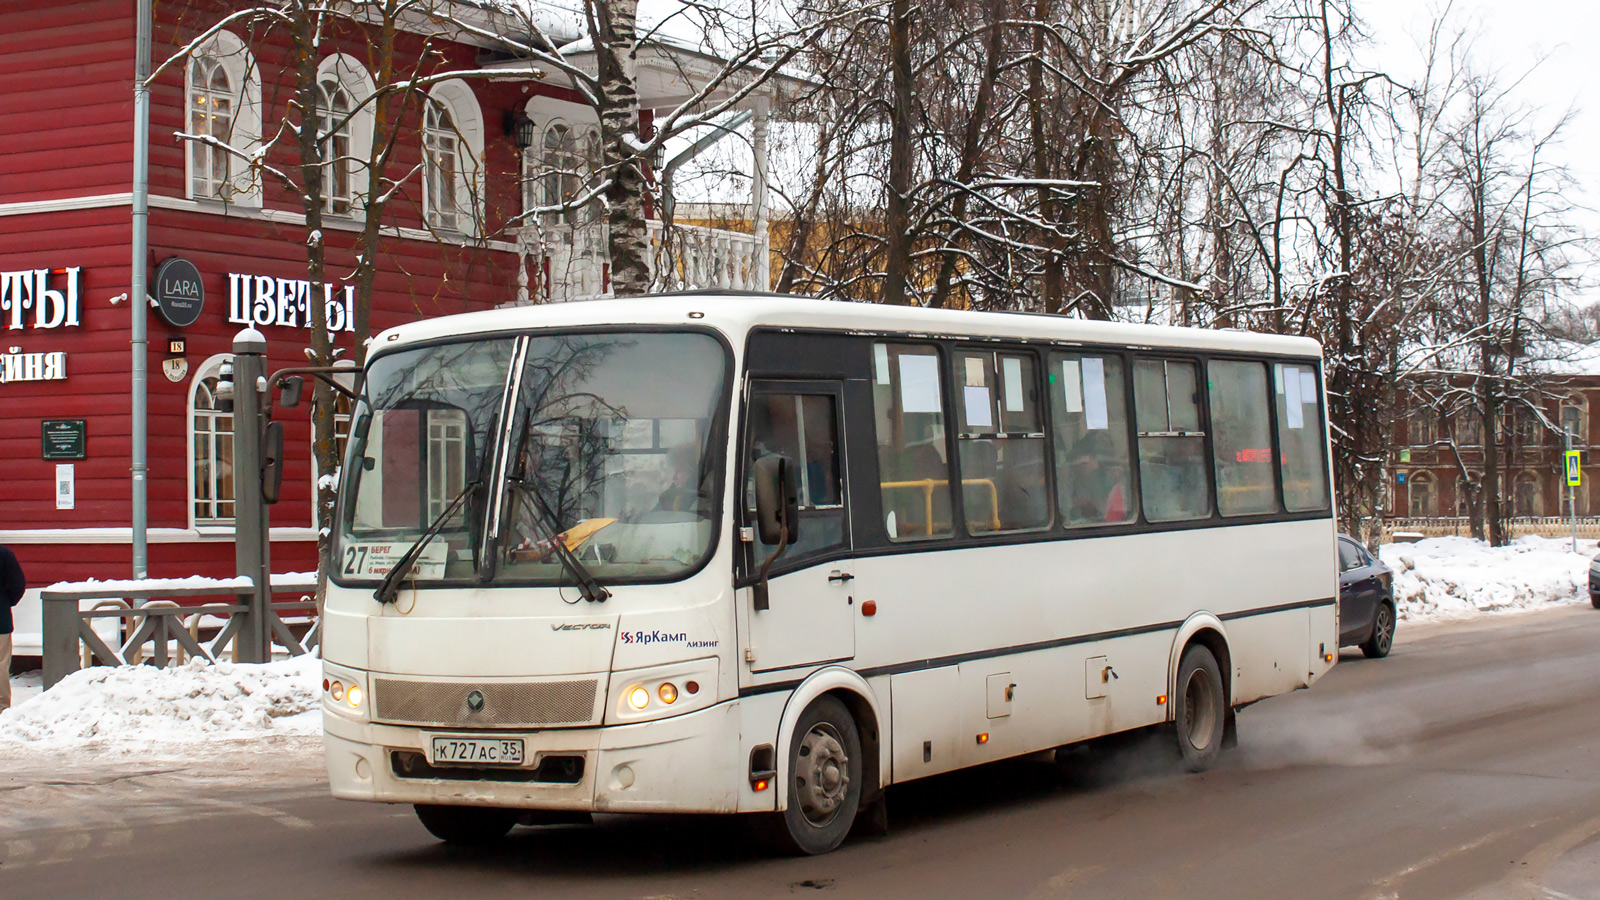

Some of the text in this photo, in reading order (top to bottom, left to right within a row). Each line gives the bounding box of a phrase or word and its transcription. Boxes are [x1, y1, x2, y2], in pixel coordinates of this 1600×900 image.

[165, 278, 200, 297] LARA
[228, 272, 356, 332] ЦВЕТЫ
[173, 342, 182, 351] 18
[171, 359, 180, 370] 18
[370, 545, 392, 554] БЕРЕГ
[344, 546, 368, 575] 27
[635, 630, 687, 645] ЯрКамп
